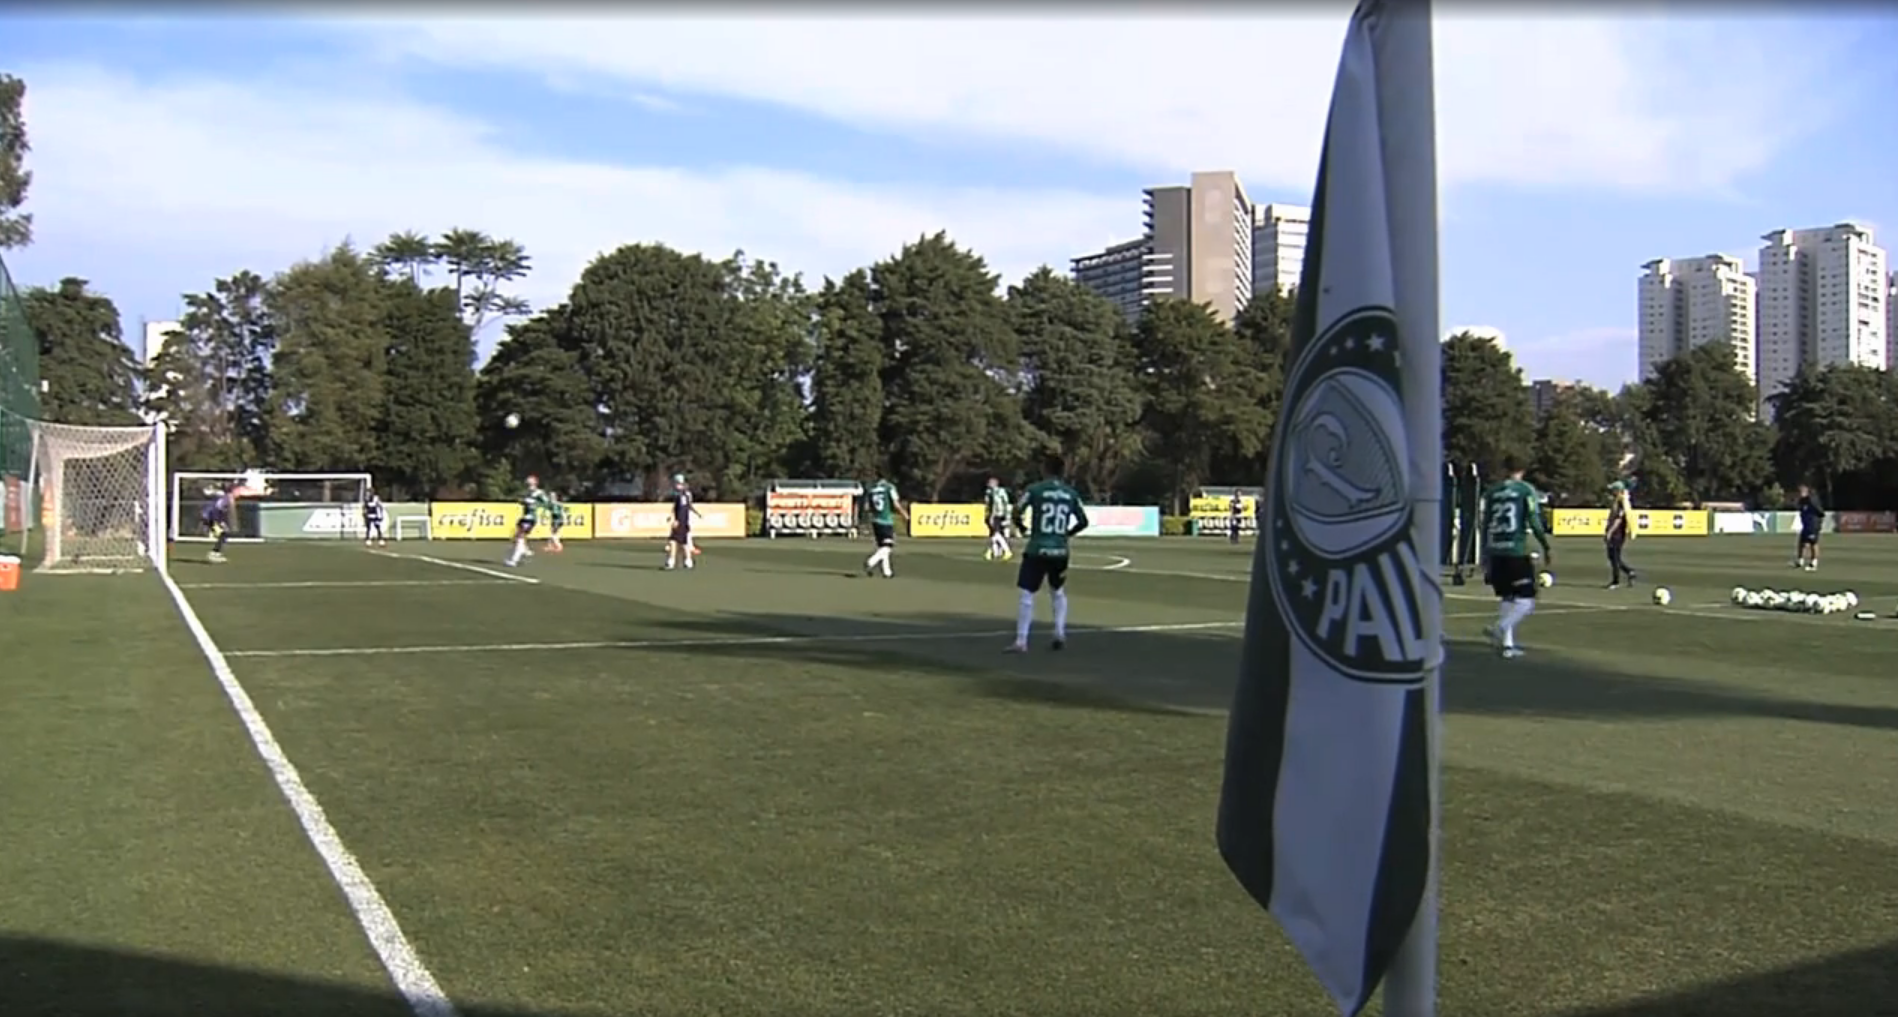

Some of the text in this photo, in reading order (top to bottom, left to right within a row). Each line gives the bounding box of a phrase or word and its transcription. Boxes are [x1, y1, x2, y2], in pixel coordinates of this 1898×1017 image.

[438, 509, 505, 532] crefisa
[917, 508, 971, 530] crefisa
[1041, 502, 1070, 534] 26
[1489, 502, 1516, 533] 23
